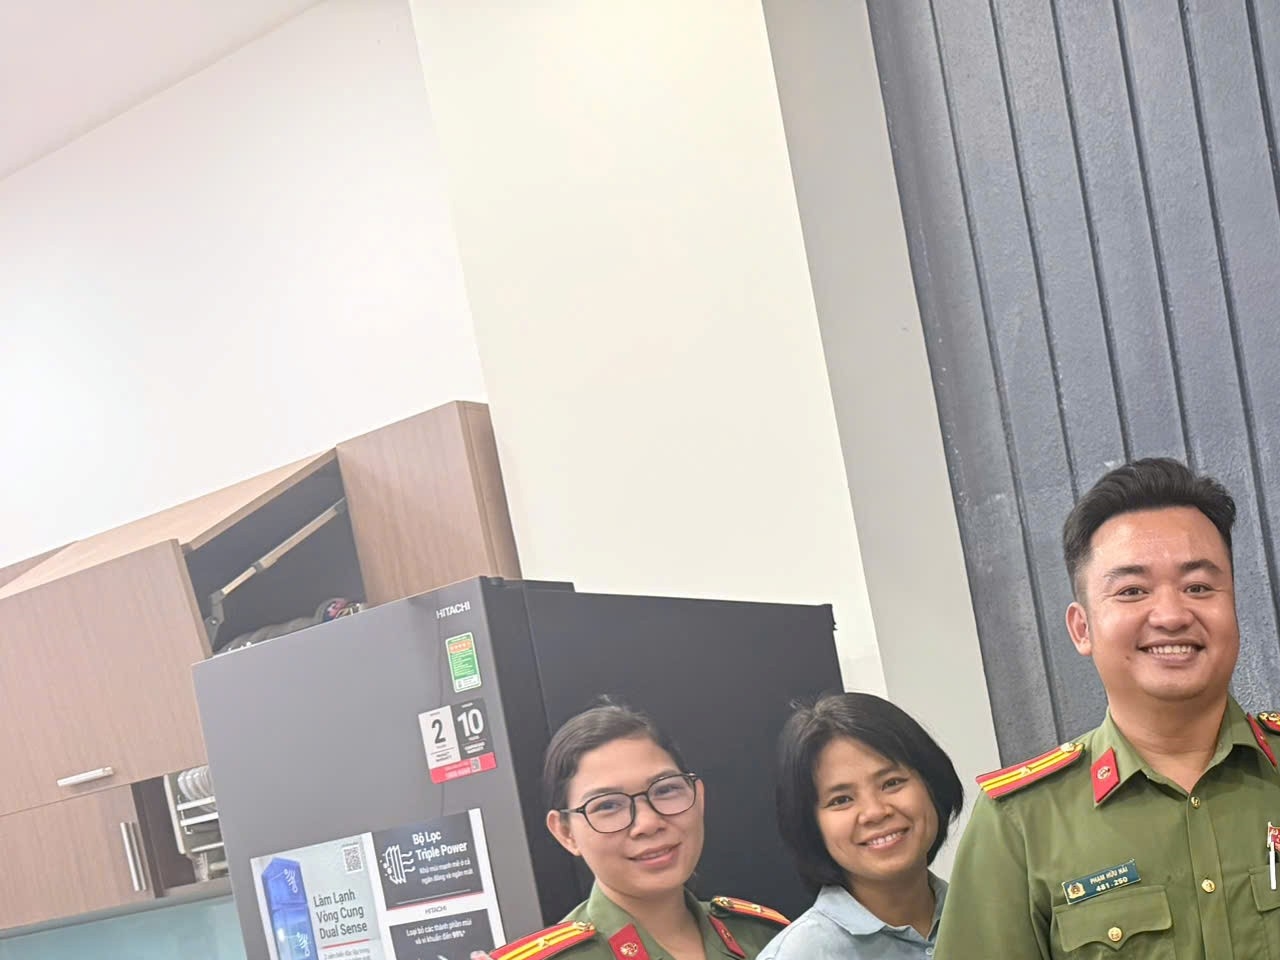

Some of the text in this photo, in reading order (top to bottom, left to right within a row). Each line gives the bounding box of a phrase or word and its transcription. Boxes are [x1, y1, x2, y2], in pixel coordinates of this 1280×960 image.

[436, 601, 471, 619] HITACHI
[432, 719, 446, 744] 2
[457, 709, 484, 736] 10
[412, 831, 442, 846] Bộ Lọc
[415, 842, 468, 861] Triple Power
[313, 888, 356, 908] Làm Lạnh
[316, 906, 364, 923] Vòng Cung
[425, 905, 447, 914] HITACHI
[320, 922, 368, 940] Dual Sense
